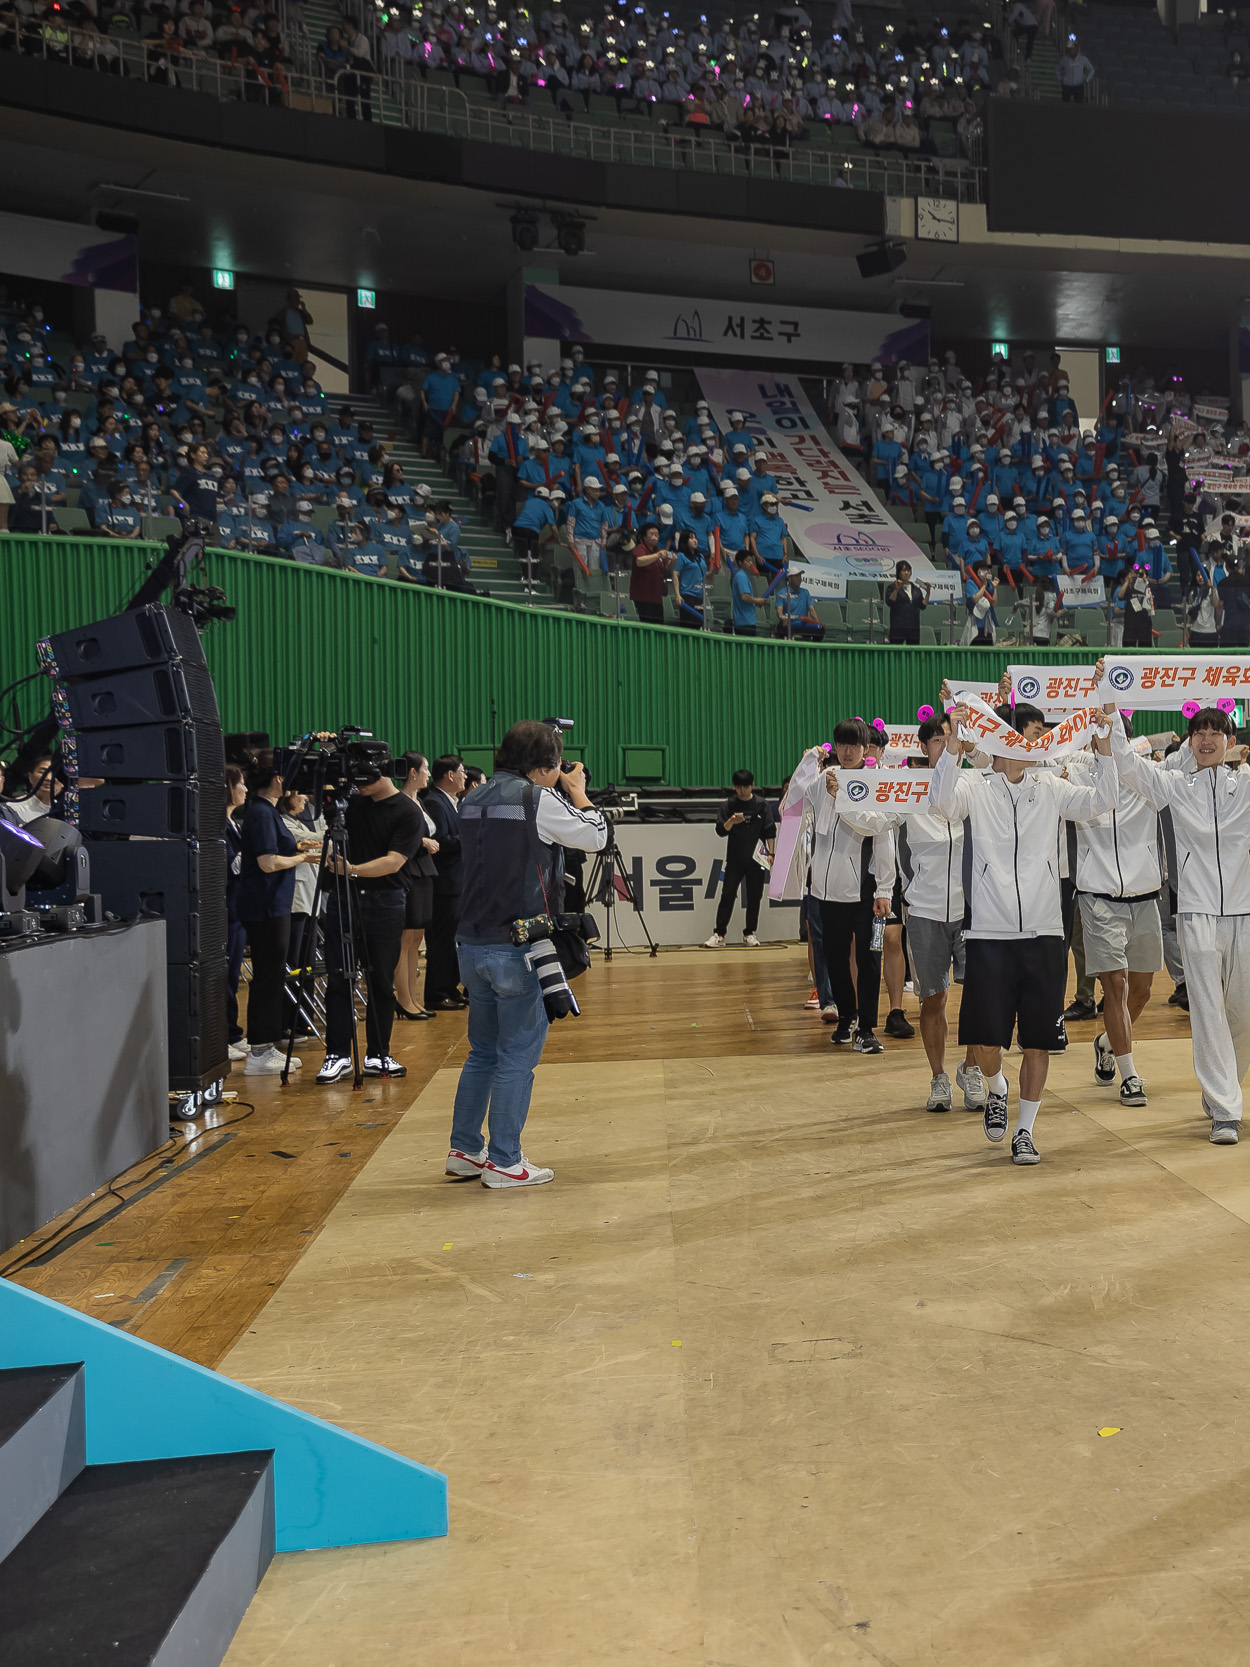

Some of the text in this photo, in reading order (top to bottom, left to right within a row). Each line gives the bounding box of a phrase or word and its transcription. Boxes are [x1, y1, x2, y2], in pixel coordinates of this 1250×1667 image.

[722, 315, 801, 344] 서초구
[757, 383, 810, 430] 내일이
[784, 434, 862, 496] 기다려지는
[839, 499, 889, 526] 서초
[1045, 677, 1096, 699] 광진구
[1140, 666, 1197, 690] 광진구
[875, 781, 930, 804] 광진구
